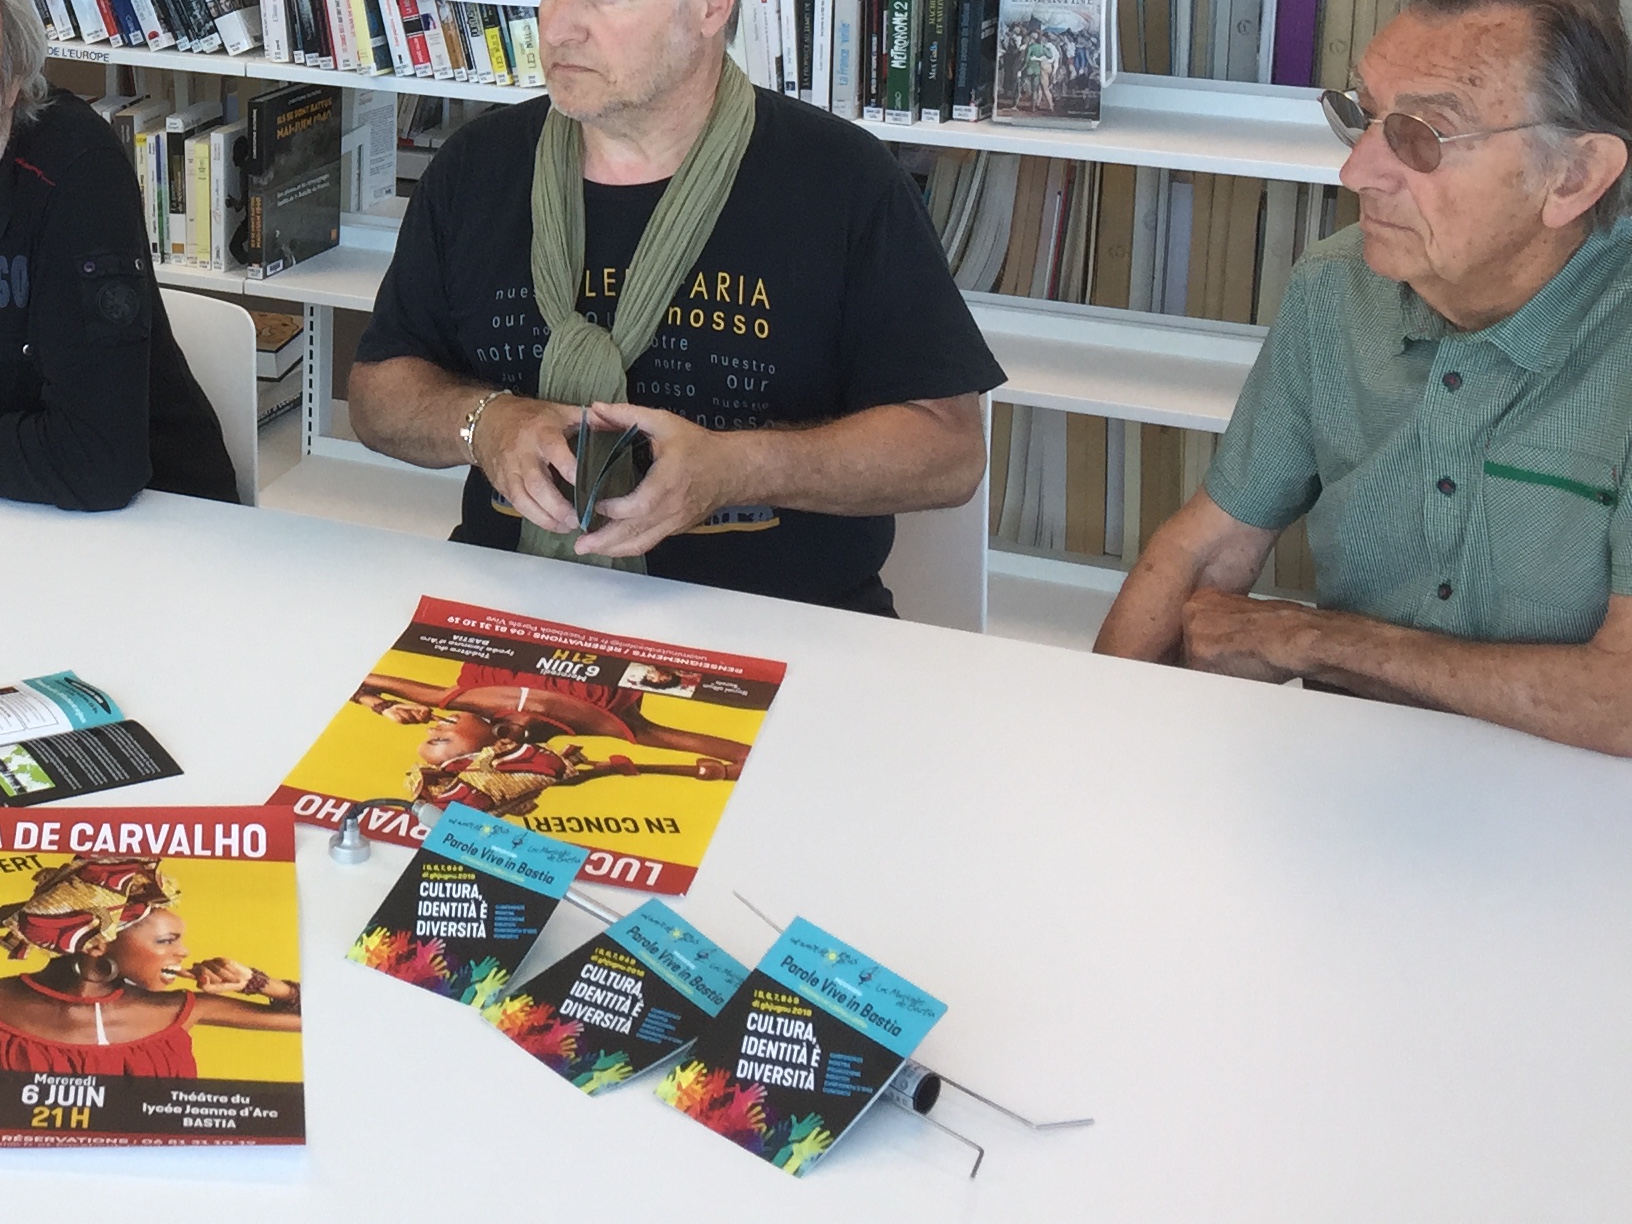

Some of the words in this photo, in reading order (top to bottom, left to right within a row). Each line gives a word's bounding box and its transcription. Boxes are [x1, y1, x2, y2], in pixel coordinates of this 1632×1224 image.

[48, 47, 61, 57] DE
[63, 48, 110, 62] L'EUROPE
[492, 313, 526, 328] our
[669, 306, 769, 338] nosso
[477, 343, 544, 362] notre
[655, 358, 691, 372] notre
[710, 353, 776, 374] nuestro
[637, 380, 695, 396] nosso
[727, 375, 768, 392] our
[553, 649, 563, 659] H
[574, 654, 598, 665] 21
[537, 656, 583, 672] JUIN
[588, 665, 600, 676] 6
[524, 817, 639, 833] CONCERT
[650, 818, 680, 833] EN
[13, 820, 59, 851] DE
[70, 823, 267, 857] CARVALHO
[443, 833, 478, 857] Parole
[480, 848, 502, 866] Vive
[504, 857, 516, 870] in
[518, 861, 555, 884] Bastia
[420, 882, 482, 901] CULTURA,
[418, 901, 477, 918] IDENTITÀ
[416, 920, 486, 938] DIVERSITÀ
[580, 964, 643, 997] CULTURA,
[570, 980, 632, 1013] IDENTITÀ
[780, 954, 819, 987] Parole
[821, 977, 846, 1003] Vive
[846, 993, 860, 1013] in
[860, 1002, 903, 1038] Bastia
[559, 999, 633, 1035] DIVERSITÀ
[747, 1013, 816, 1043] CULTURA,
[741, 1035, 808, 1065] IDENTITÀ
[35, 1073, 96, 1086] Mercredi
[736, 1059, 815, 1091] DIVERSITÀ
[22, 1085, 38, 1104] 6
[45, 1085, 104, 1108] JUIN
[171, 1091, 228, 1104] Théâtre
[231, 1094, 250, 1104] du
[31, 1107, 66, 1127] 21
[71, 1108, 89, 1128] H
[143, 1102, 181, 1116] lycée
[184, 1105, 231, 1116] Jeanne
[236, 1106, 278, 1118] d'Arc
[183, 1118, 236, 1128] BASTIA
[2, 1132, 128, 1145] RÉSERVATIONS
